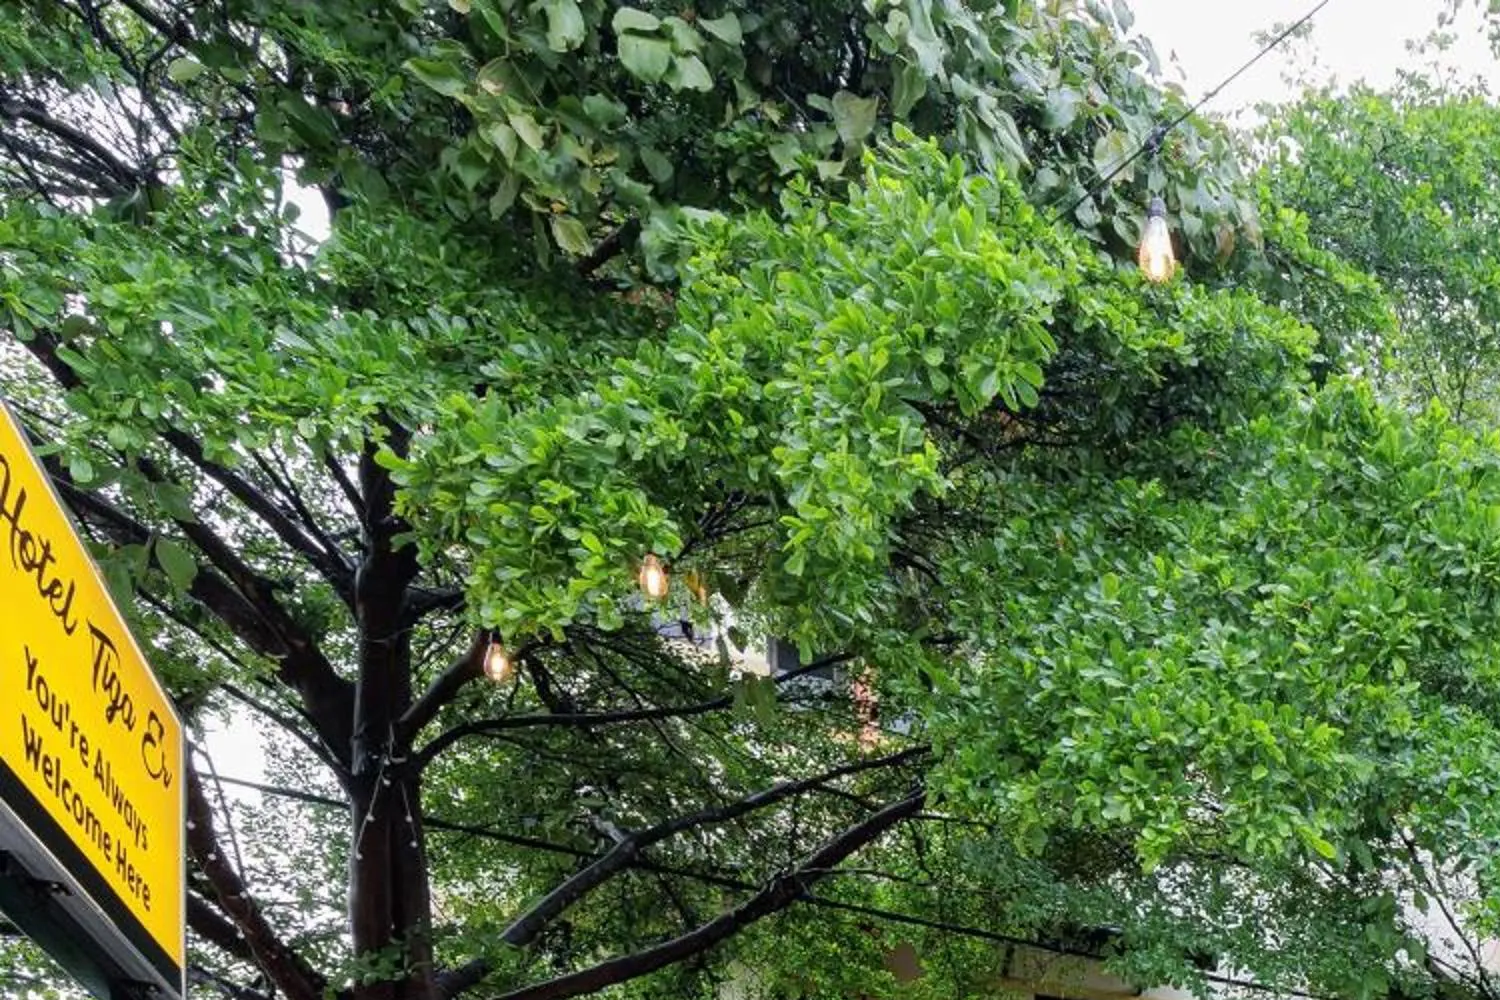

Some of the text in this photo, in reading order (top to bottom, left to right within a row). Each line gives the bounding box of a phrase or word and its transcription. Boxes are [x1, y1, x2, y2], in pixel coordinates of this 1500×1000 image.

[0, 453, 77, 637] Hotel
[86, 617, 137, 733] Tiga
[21, 712, 151, 913] Welcome Here
[24, 644, 149, 851] You're Always
